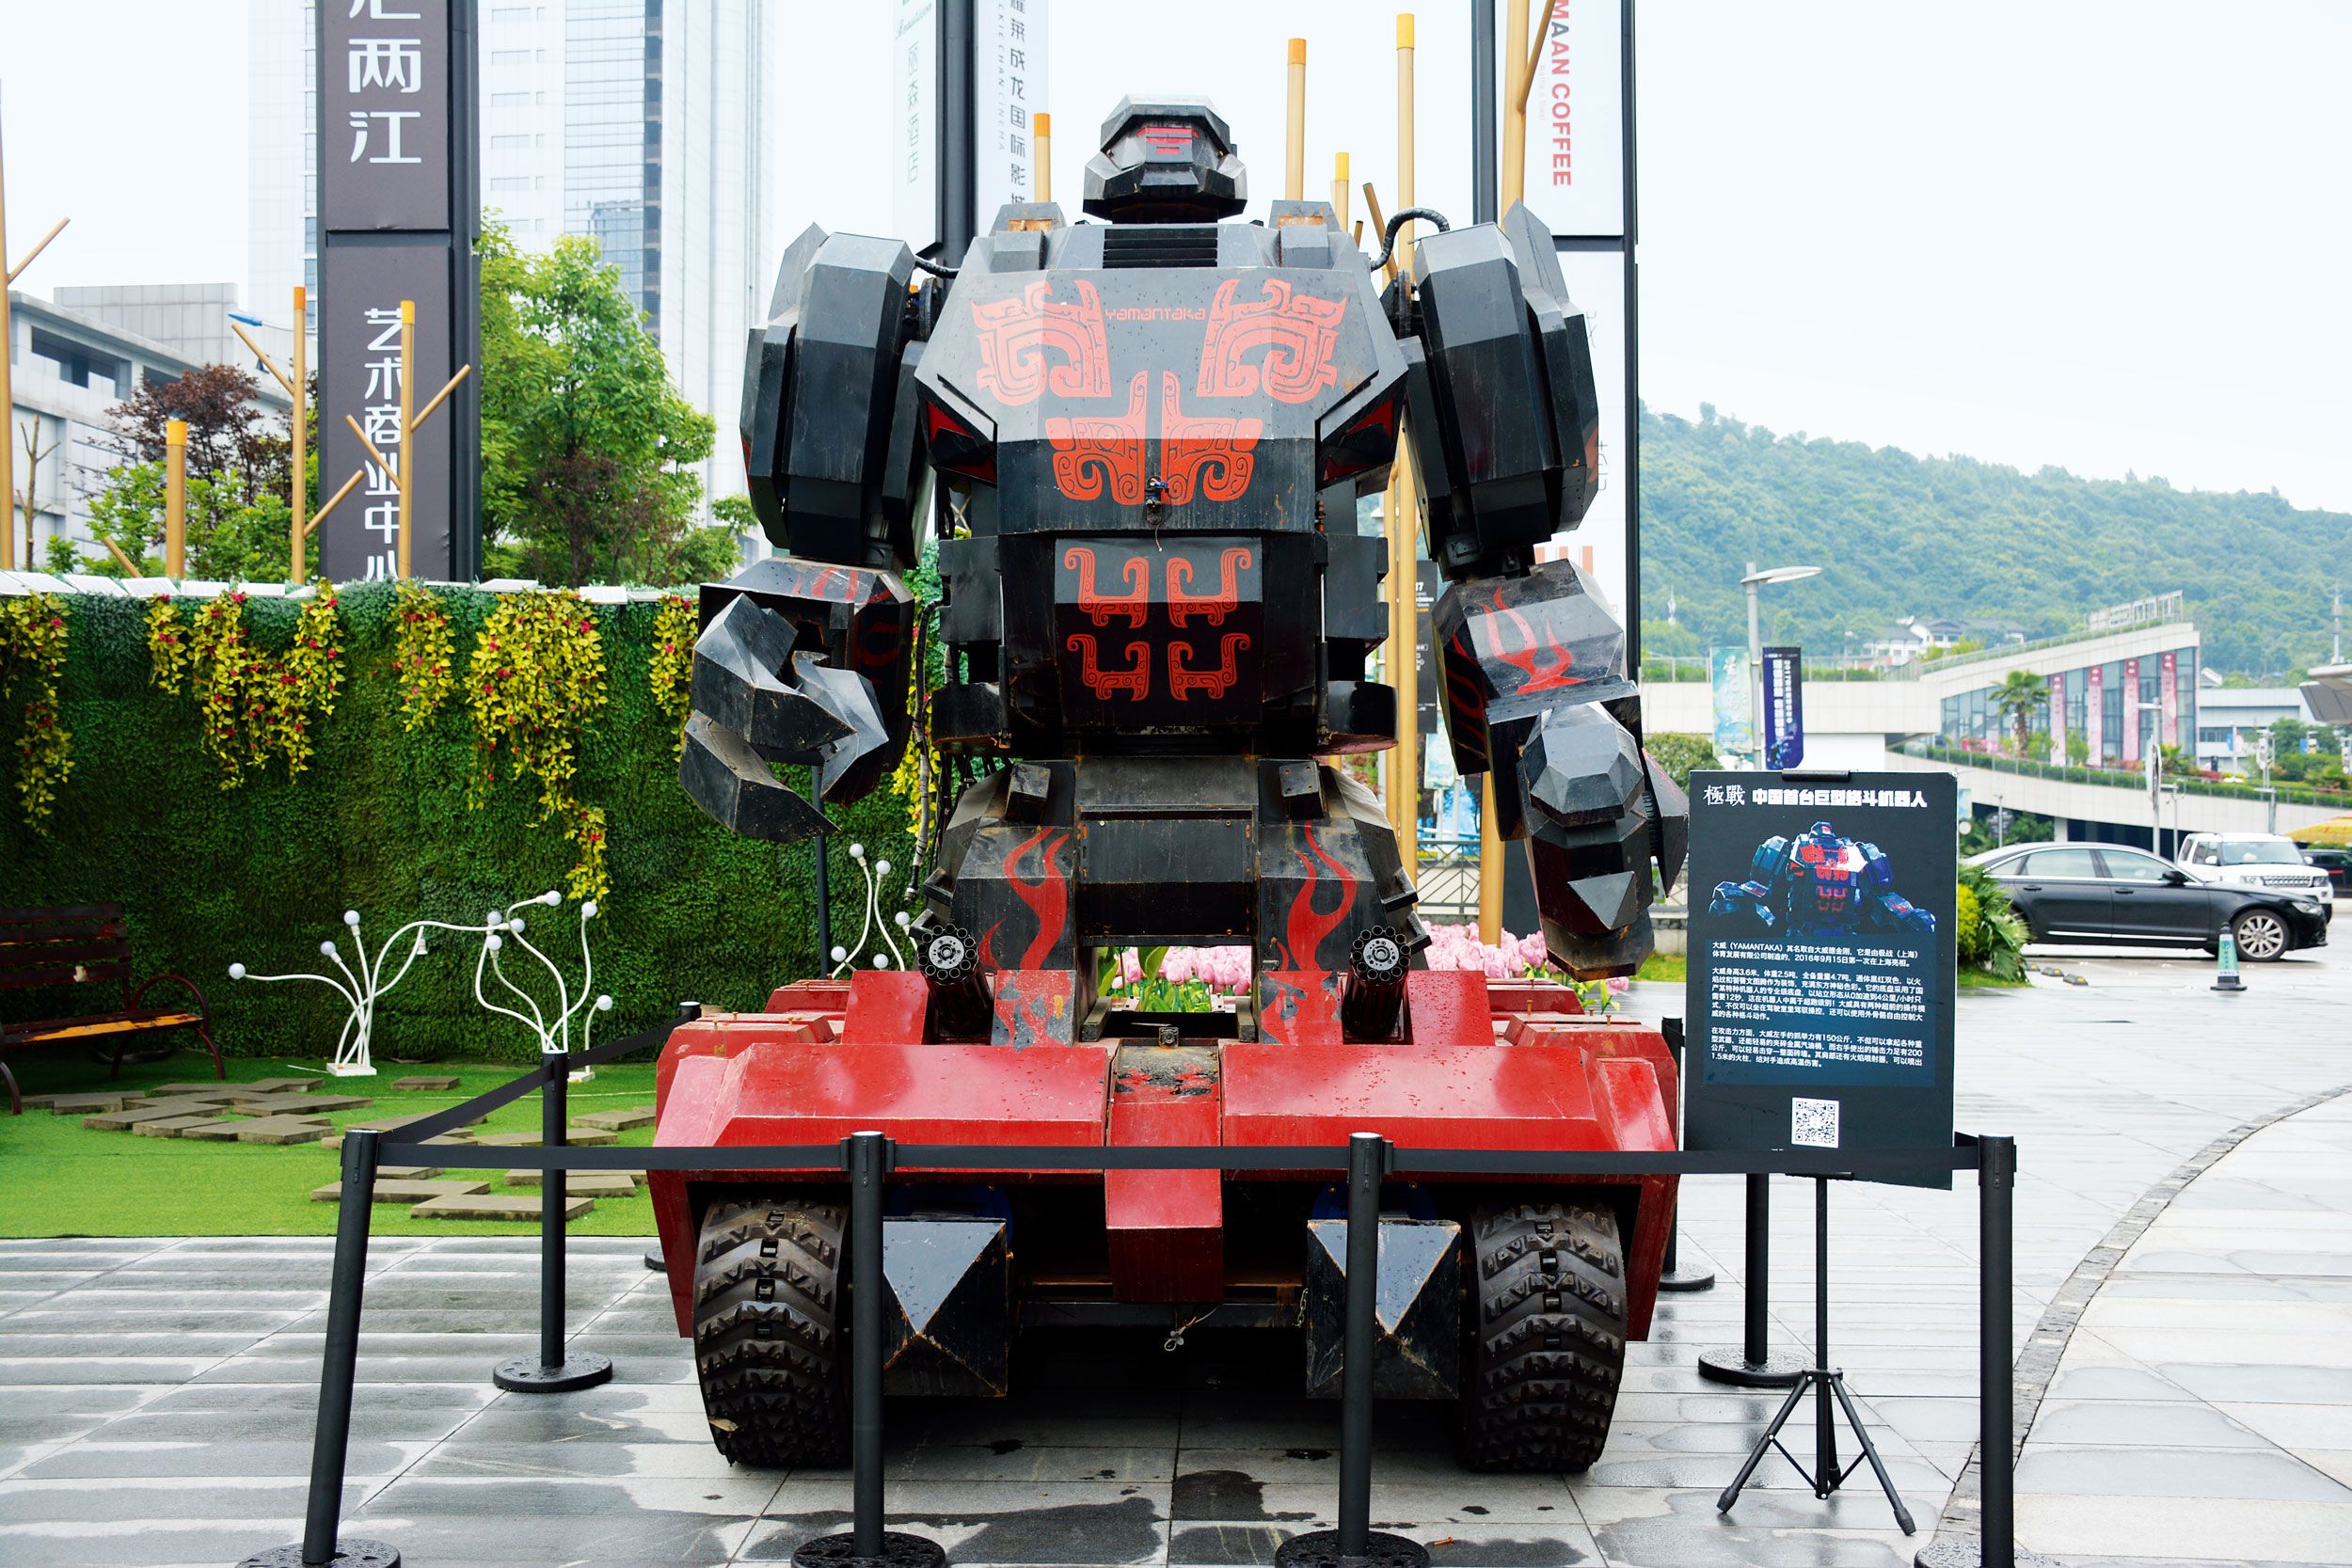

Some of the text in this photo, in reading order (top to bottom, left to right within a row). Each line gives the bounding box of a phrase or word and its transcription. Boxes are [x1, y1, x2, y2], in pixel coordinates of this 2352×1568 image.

[1551, 83, 1572, 186] COFFEE
[1703, 784, 1928, 808] 極戰 中国首台巨型格斗机器人
